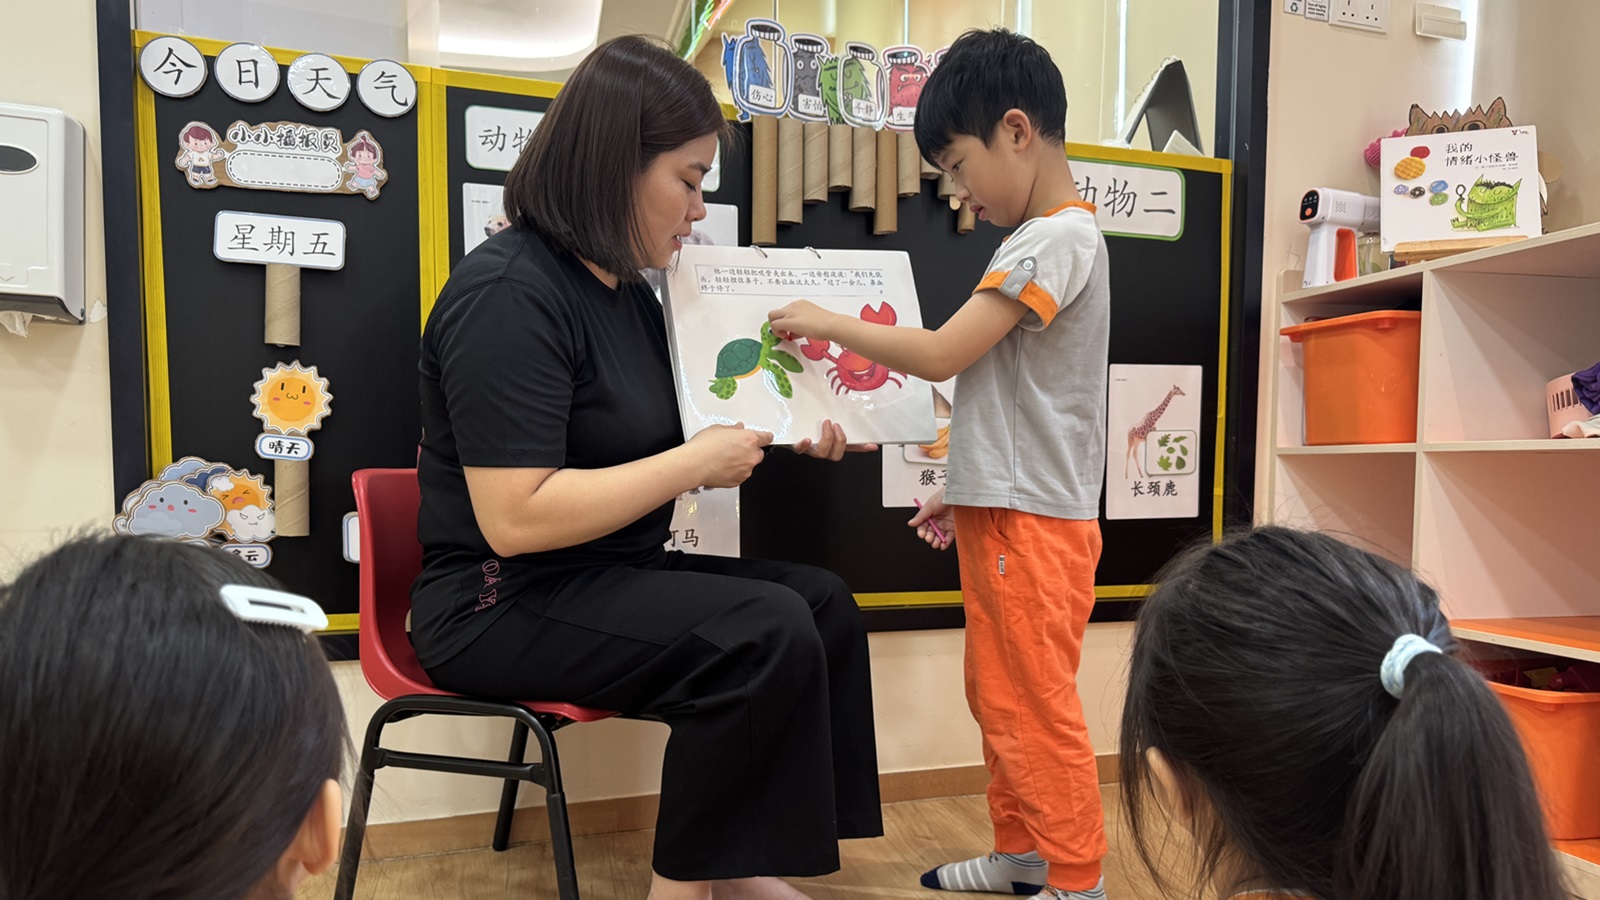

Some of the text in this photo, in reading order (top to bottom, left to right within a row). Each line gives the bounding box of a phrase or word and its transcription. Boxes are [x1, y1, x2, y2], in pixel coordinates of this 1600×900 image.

[152, 46, 409, 108] 今日天气
[751, 89, 773, 103] 伤心
[803, 97, 823, 111] 害怕
[230, 124, 341, 152] 小小播报员
[1445, 142, 1473, 154] 我的
[1445, 151, 1519, 167] 情绪小怪兽
[228, 222, 336, 258] 星期五
[268, 440, 301, 455] 晴天
[1131, 480, 1178, 497] 长颈鹿
